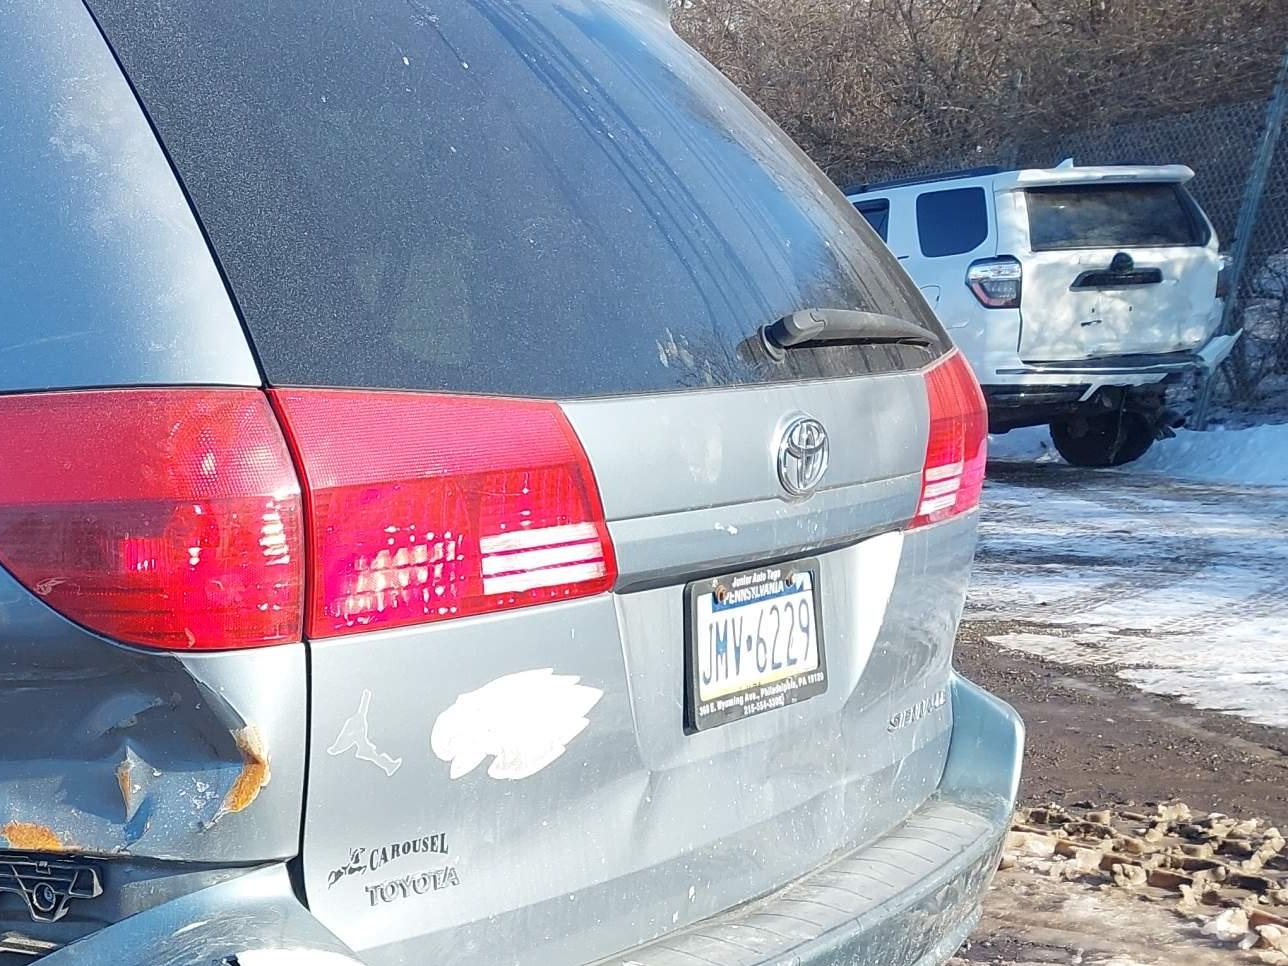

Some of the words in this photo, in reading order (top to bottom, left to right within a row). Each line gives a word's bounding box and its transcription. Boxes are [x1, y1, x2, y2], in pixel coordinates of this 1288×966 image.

[723, 580, 784, 606] PENNSYLVANIA
[369, 832, 449, 872] CAROUSEL
[365, 866, 460, 907] TOYOTA
